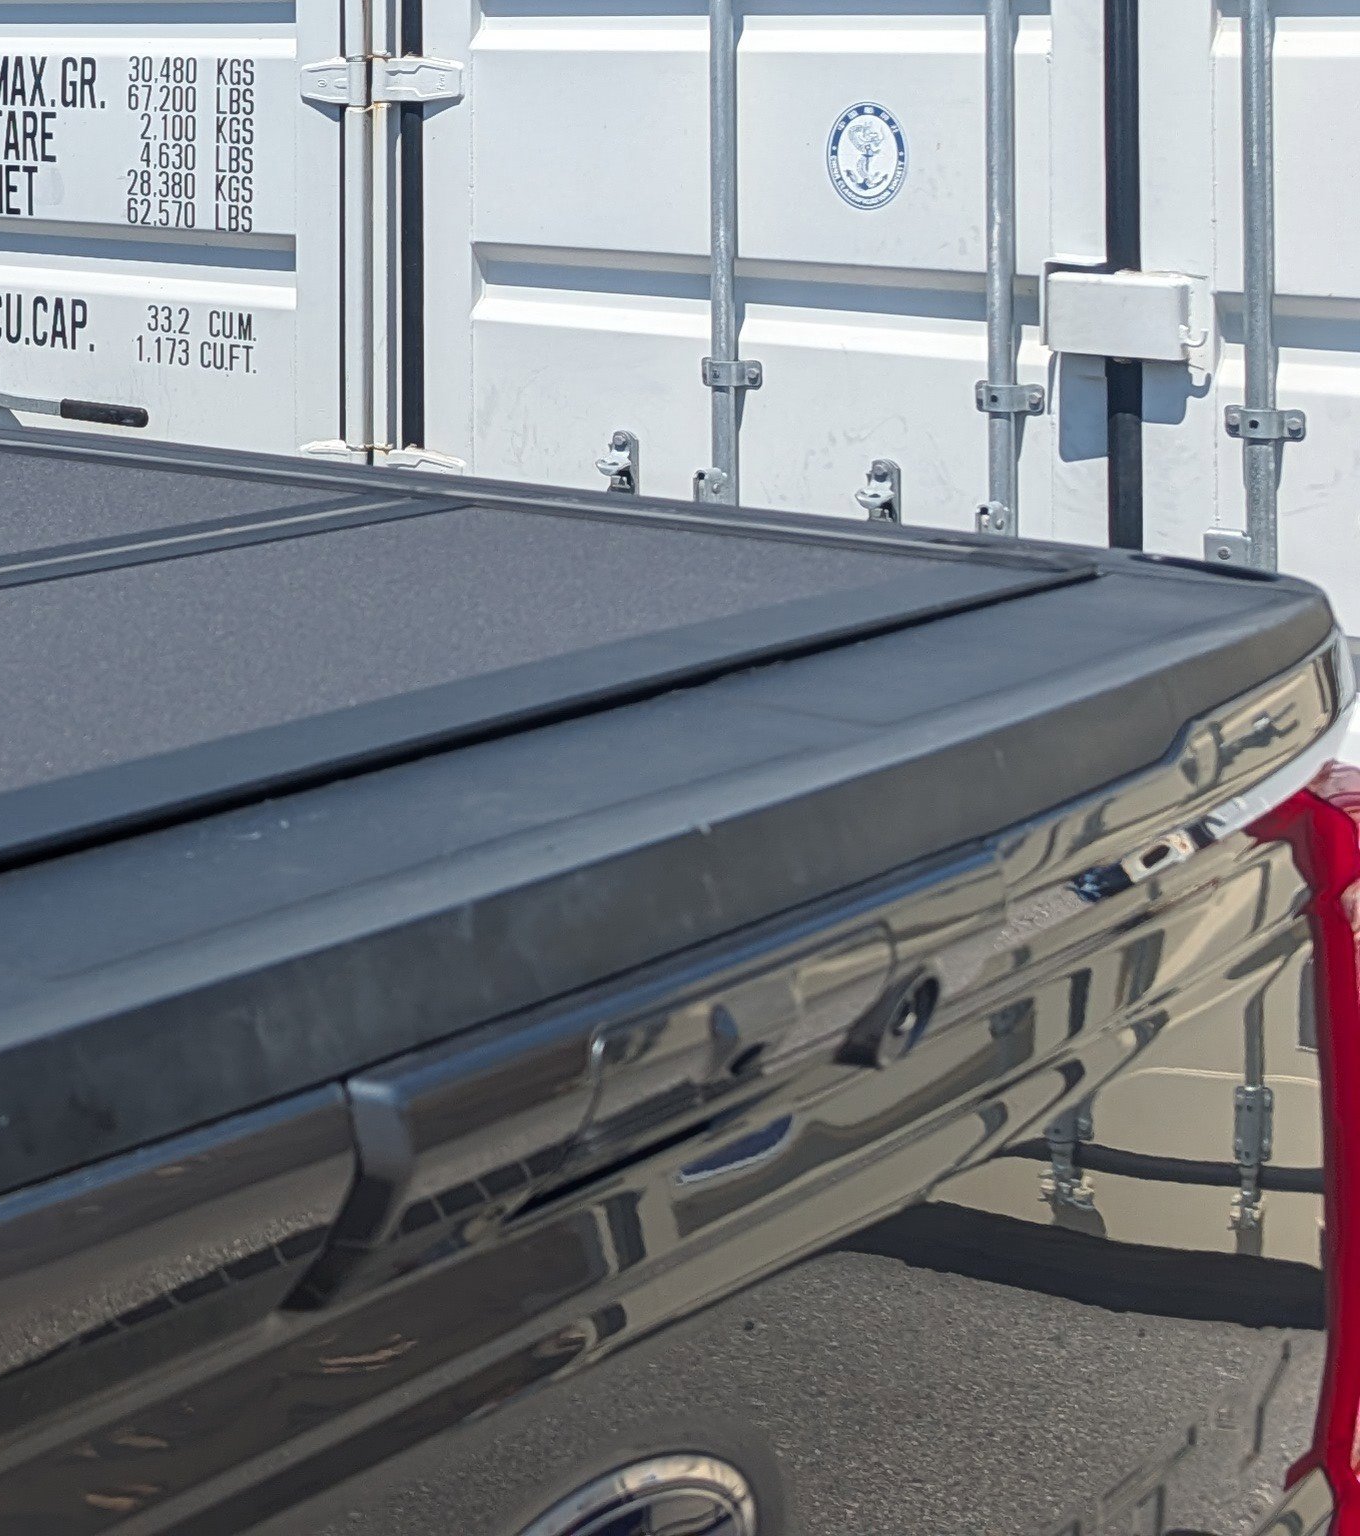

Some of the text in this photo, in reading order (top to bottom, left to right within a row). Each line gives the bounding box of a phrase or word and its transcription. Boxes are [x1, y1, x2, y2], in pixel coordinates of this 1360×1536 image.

[128, 56, 197, 84] 30,480
[216, 57, 255, 86] KGS
[128, 85, 255, 115] 67,200 LBS
[140, 113, 254, 145] 2,100 KGS
[140, 142, 254, 174] 4,630 LBS
[215, 175, 254, 203] KGS
[127, 197, 254, 233] 62,570 LBS
[147, 305, 257, 342] 33.2 CU.M.
[136, 335, 257, 374] 1,173 CU.FT.
